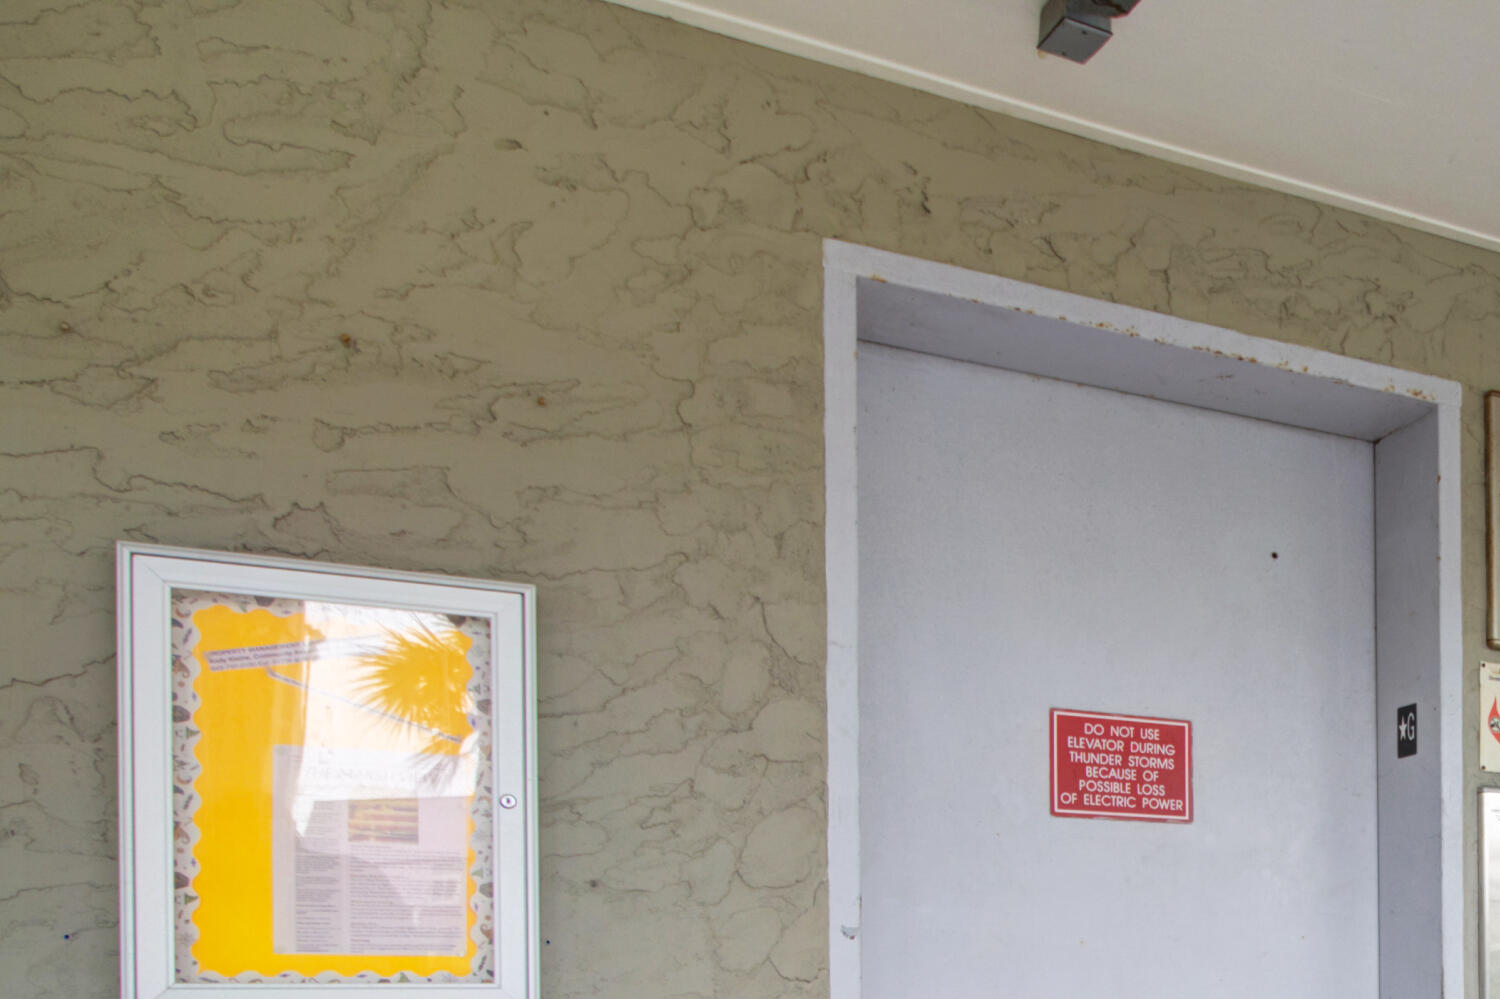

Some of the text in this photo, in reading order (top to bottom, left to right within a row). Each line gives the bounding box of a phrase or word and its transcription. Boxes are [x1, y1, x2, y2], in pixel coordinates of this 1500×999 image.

[1084, 723, 1160, 741] DO NOT USE
[1407, 712, 1415, 741] G
[1067, 736, 1176, 756] ELEVATOR DURING
[1069, 751, 1175, 770] THUNDER STORMS
[1085, 766, 1159, 782] BECAUSE OF
[1079, 780, 1166, 797] POSSIBLE LOSS
[1060, 792, 1184, 811] OF ELECTRIC POWER
